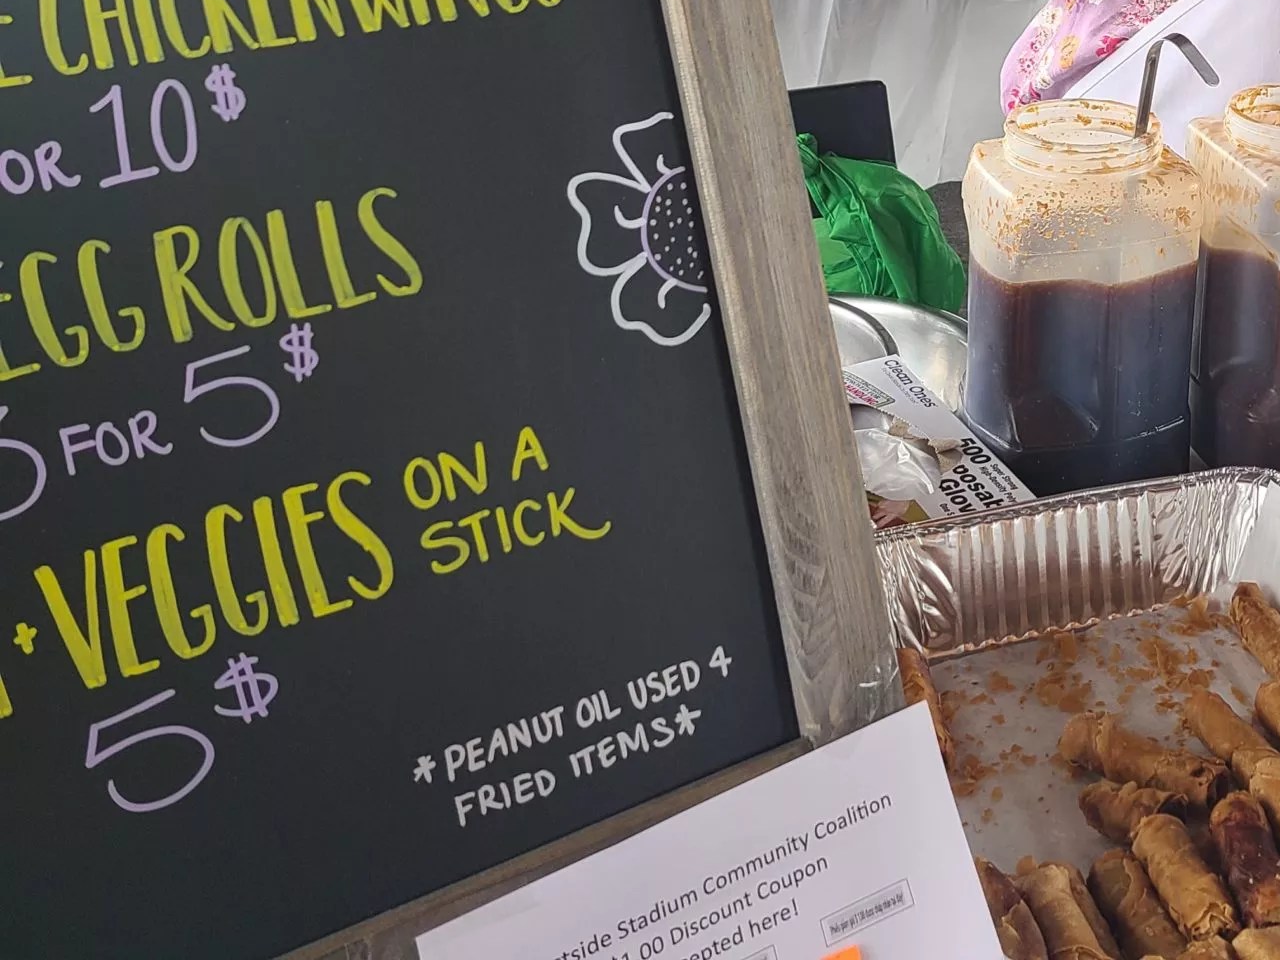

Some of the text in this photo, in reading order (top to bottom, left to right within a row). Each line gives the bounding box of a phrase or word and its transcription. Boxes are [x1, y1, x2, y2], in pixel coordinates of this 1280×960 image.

[154, 186, 424, 342] ROLLS
[884, 359, 913, 386] Clean
[909, 385, 937, 408] Ones
[59, 409, 173, 476] FOR
[403, 441, 488, 510] ON
[511, 426, 549, 482] A
[960, 437, 992, 465] 500
[420, 487, 611, 574] STICK
[575, 688, 621, 731] OIL
[627, 659, 702, 710] USED
[709, 645, 733, 679] 4
[454, 766, 557, 828] FRIED
[617, 887, 700, 940] Stadium
[702, 832, 811, 896] Community
[813, 792, 894, 841] Coalition
[669, 892, 753, 946] Discount
[757, 853, 830, 901] Coupon
[748, 897, 800, 939] here!
